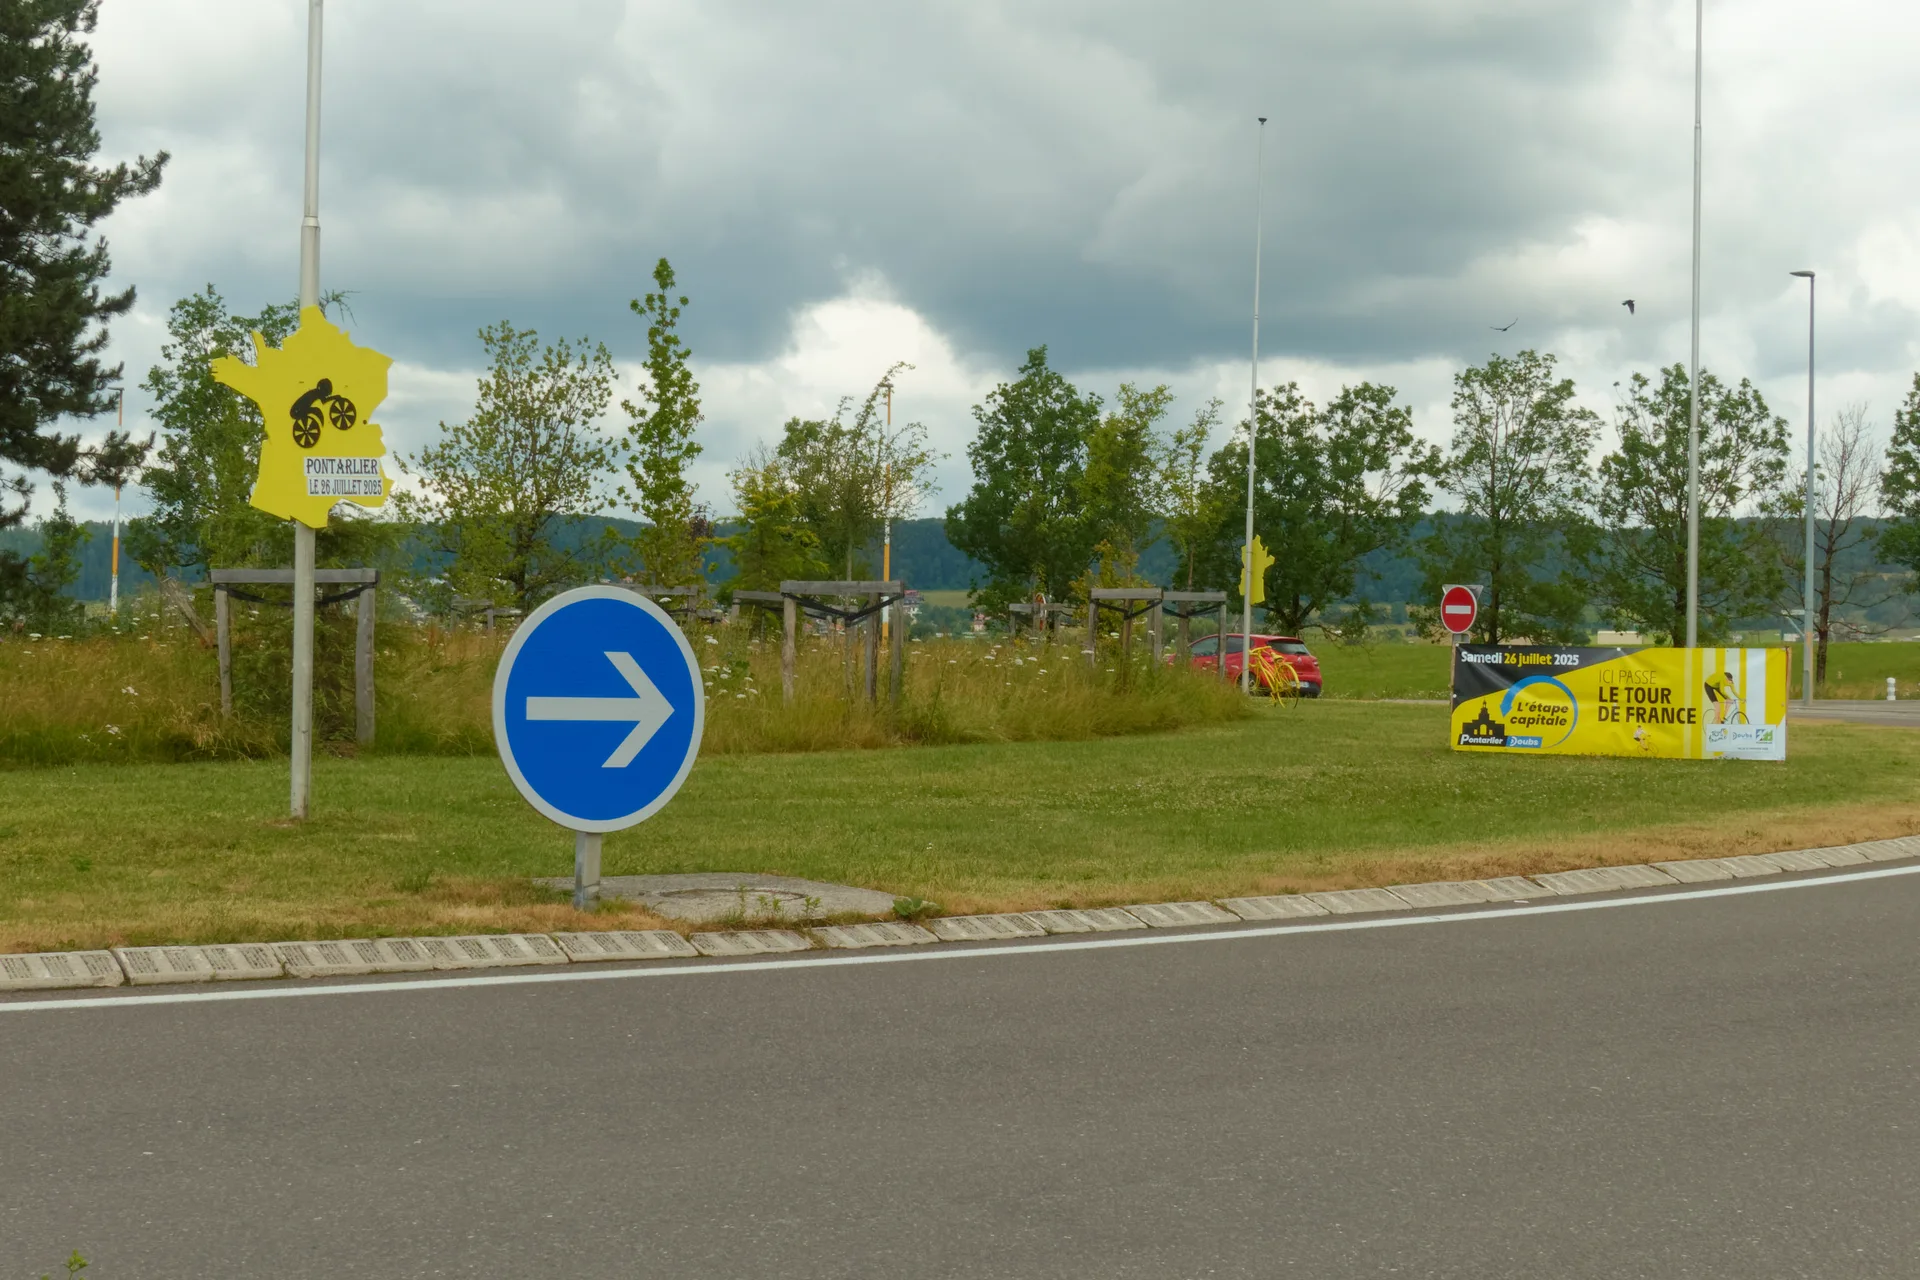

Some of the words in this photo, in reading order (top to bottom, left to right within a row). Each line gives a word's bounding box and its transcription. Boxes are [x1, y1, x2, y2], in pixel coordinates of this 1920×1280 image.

[306, 458, 378, 475] PONTARLIER
[309, 479, 319, 495] LE
[320, 479, 331, 495] 26
[332, 479, 362, 495] JUILLET
[363, 479, 383, 496] 2025
[1461, 651, 1503, 664] Samedi
[1504, 653, 1517, 665] 26
[1517, 653, 1552, 667] juillet
[1553, 654, 1580, 666] 2025
[1599, 669, 1614, 684] ICI
[1618, 670, 1657, 685] PASSE
[1598, 686, 1619, 703] LE
[1624, 687, 1672, 704] TOUR
[1517, 701, 1569, 717] L'étape
[1598, 705, 1621, 723] DE
[1625, 706, 1697, 725] FRANCE
[1510, 715, 1568, 729] capitale
[1460, 734, 1504, 745] Pontarlier
[1509, 736, 1539, 747] Doubs
